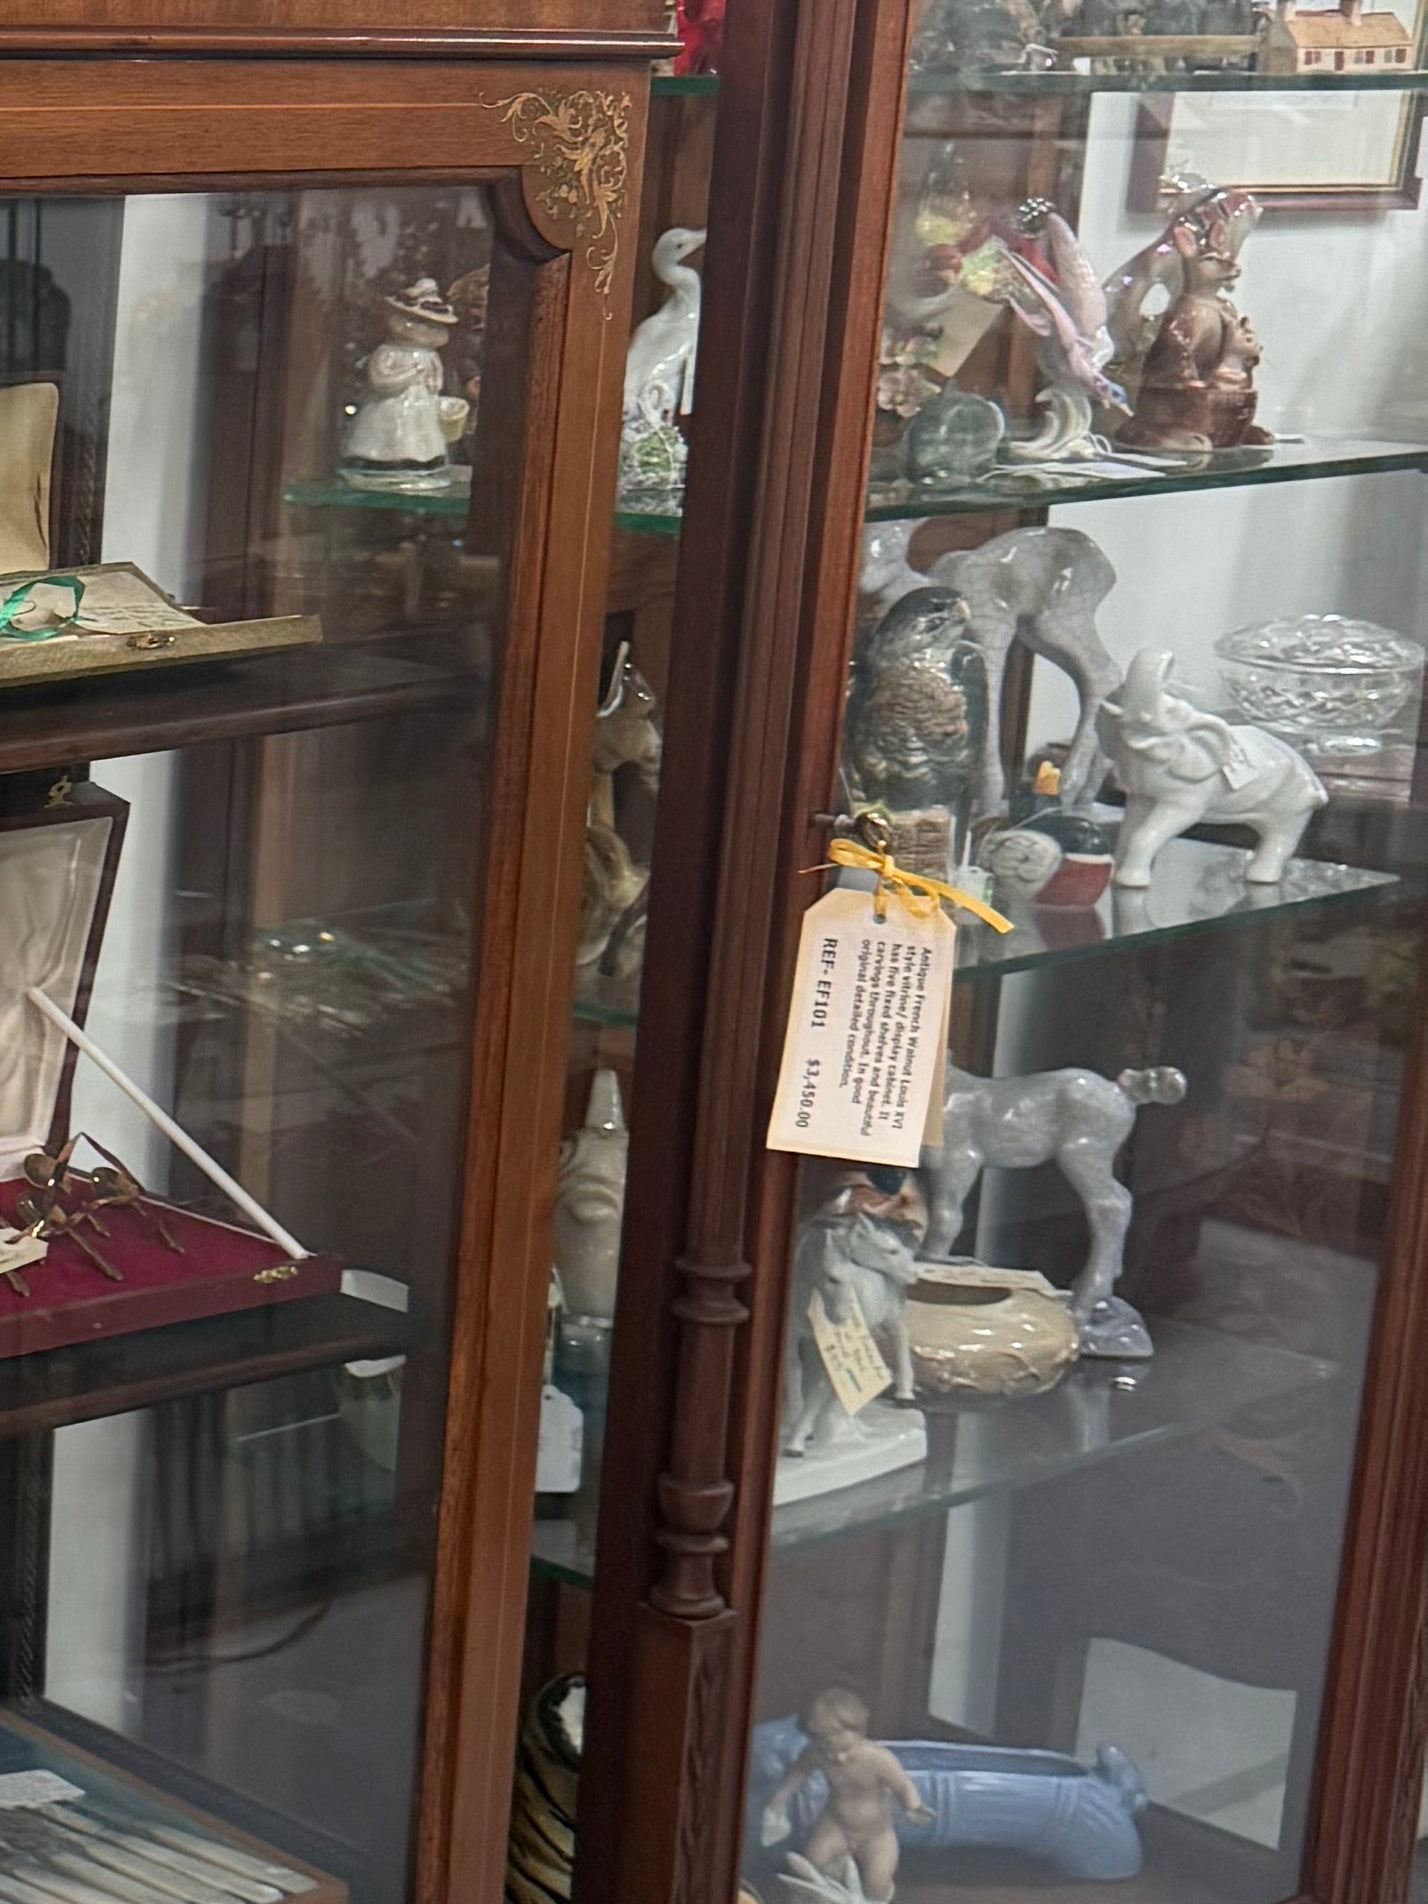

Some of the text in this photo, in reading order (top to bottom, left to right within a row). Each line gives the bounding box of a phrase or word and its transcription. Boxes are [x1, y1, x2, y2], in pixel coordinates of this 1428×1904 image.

[857, 938, 873, 983] original
[869, 941, 886, 989] carvings
[890, 943, 903, 963] has
[903, 945, 916, 973] style
[885, 966, 900, 987] five
[849, 985, 867, 1032] detailed
[881, 990, 896, 1019] fixed
[795, 938, 839, 1128] REF- EF101 $3,450.00
[874, 1021, 890, 1063] shelves
[887, 1021, 905, 1062] display
[891, 946, 932, 1129] Antique French Walnut Louis XVI
[851, 1077, 864, 1104] good
[869, 1066, 882, 1087] and
